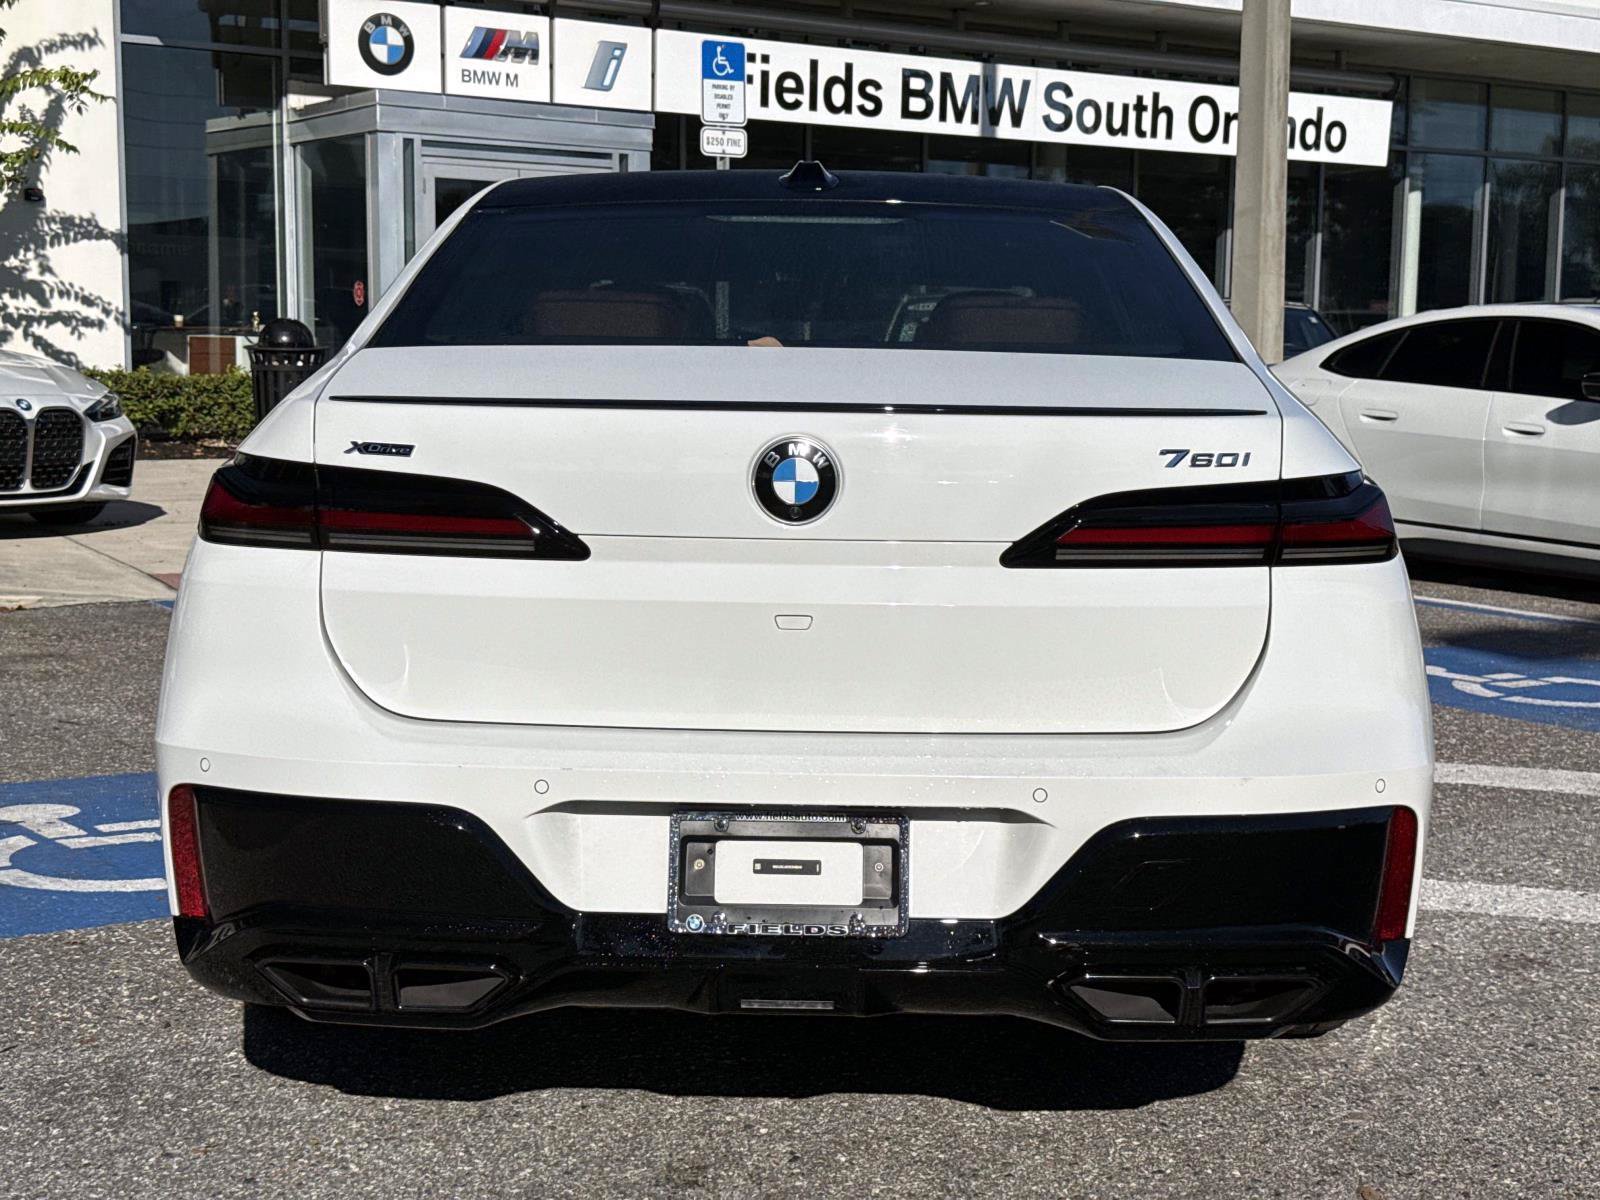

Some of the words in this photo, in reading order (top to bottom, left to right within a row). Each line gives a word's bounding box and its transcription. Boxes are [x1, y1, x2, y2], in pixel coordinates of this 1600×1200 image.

[364, 15, 410, 37] BMW
[461, 68, 502, 86] BMW
[505, 72, 519, 88] M
[901, 67, 1031, 128] BMW
[1042, 81, 1174, 140] South
[706, 136, 724, 146] $250
[726, 138, 742, 148] FINE
[764, 443, 830, 470] BMW
[727, 924, 849, 936] FIELDS
